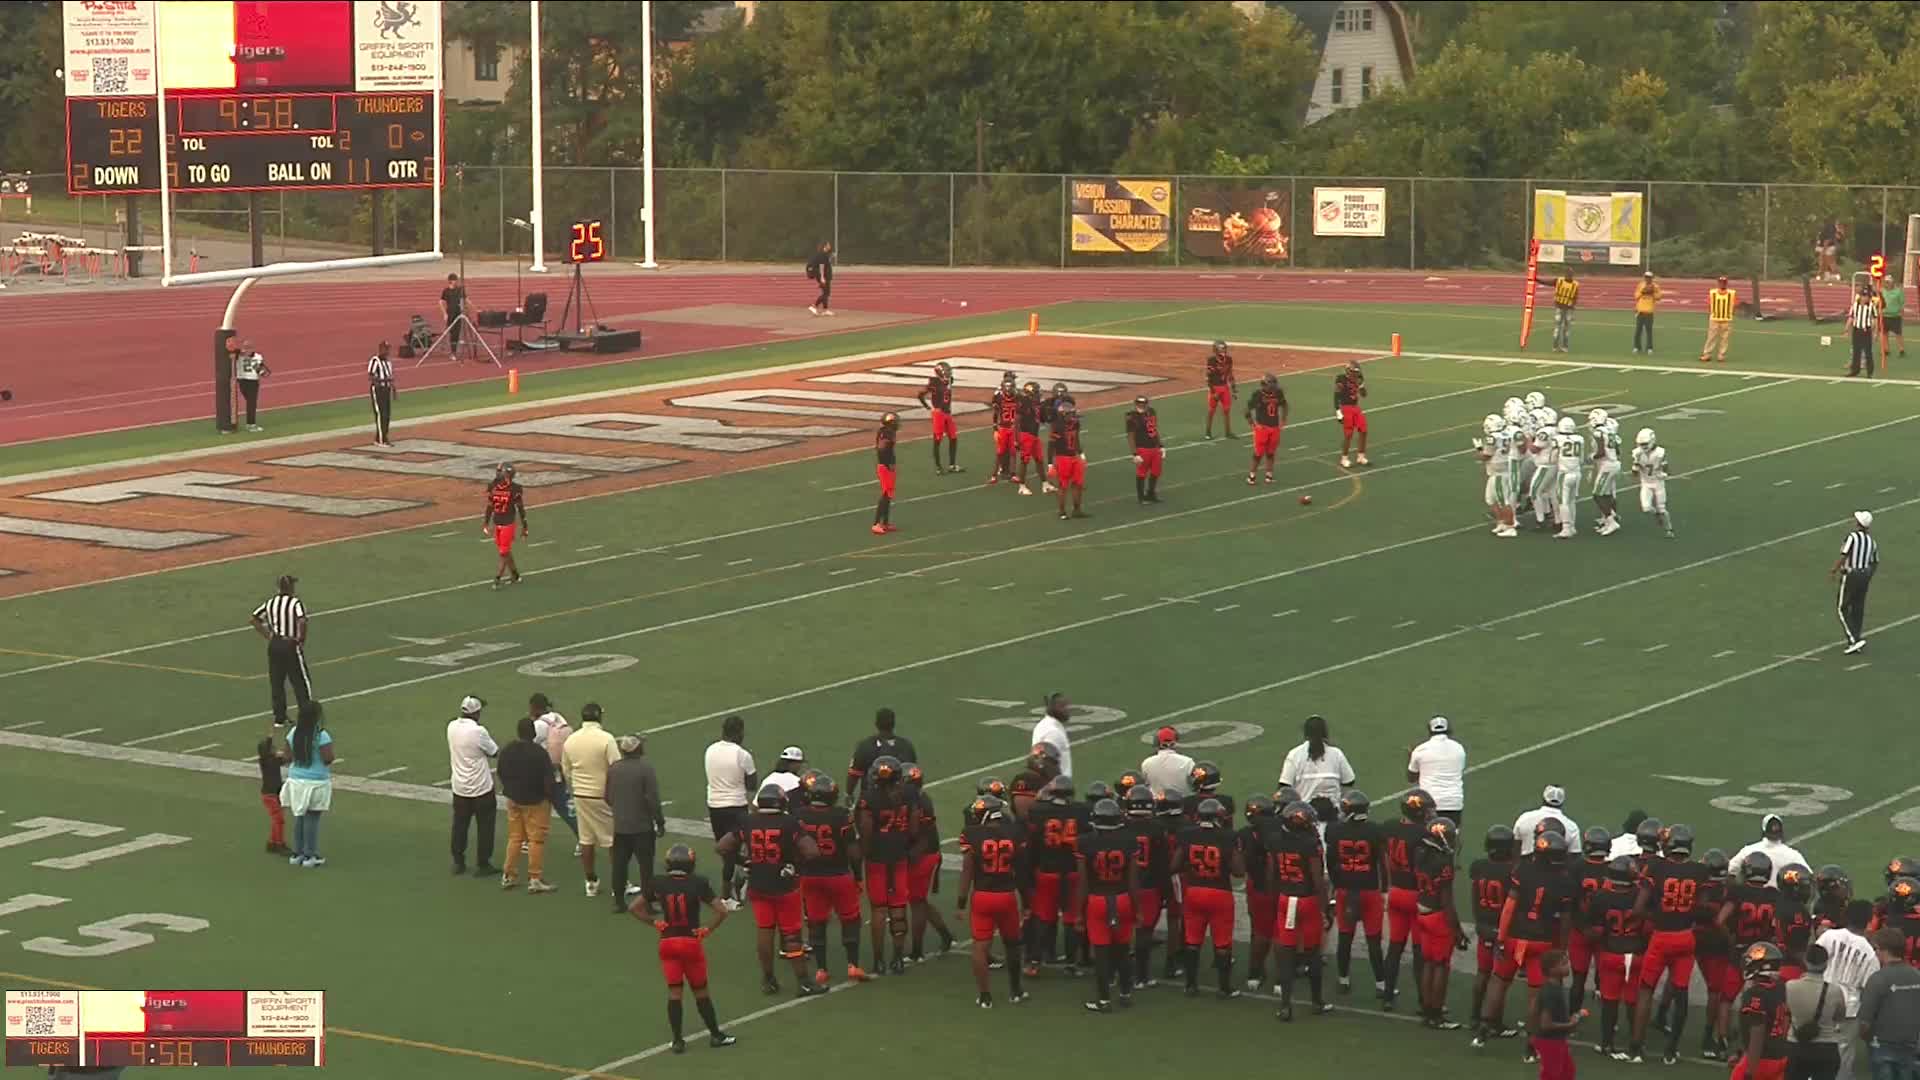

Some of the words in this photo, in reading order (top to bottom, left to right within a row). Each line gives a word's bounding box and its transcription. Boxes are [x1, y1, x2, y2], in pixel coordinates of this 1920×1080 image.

[359, 42, 395, 50] GRIFFIN
[371, 51, 425, 59] EQUIPMENT
[97, 101, 146, 118] TIGERS
[355, 97, 424, 113] THUNDERB
[109, 128, 143, 154] 22
[182, 138, 207, 151] TOL
[310, 136, 334, 148] TOL
[339, 130, 351, 150] 2
[388, 124, 403, 148] 0
[73, 163, 89, 189] 2
[94, 166, 139, 185] DOWN
[188, 164, 206, 183] TO
[210, 164, 231, 183] GO
[268, 163, 305, 182] BALL
[310, 162, 331, 181] ON
[388, 160, 418, 179] QTR
[1076, 183, 1106, 199] VISION
[1093, 200, 1132, 214] PASSION
[1110, 215, 1162, 230] CHARACTER
[571, 222, 603, 260] 25
[1870, 255, 1884, 277] 2
[1561, 441, 1581, 457] 20
[982, 839, 1014, 873] 92
